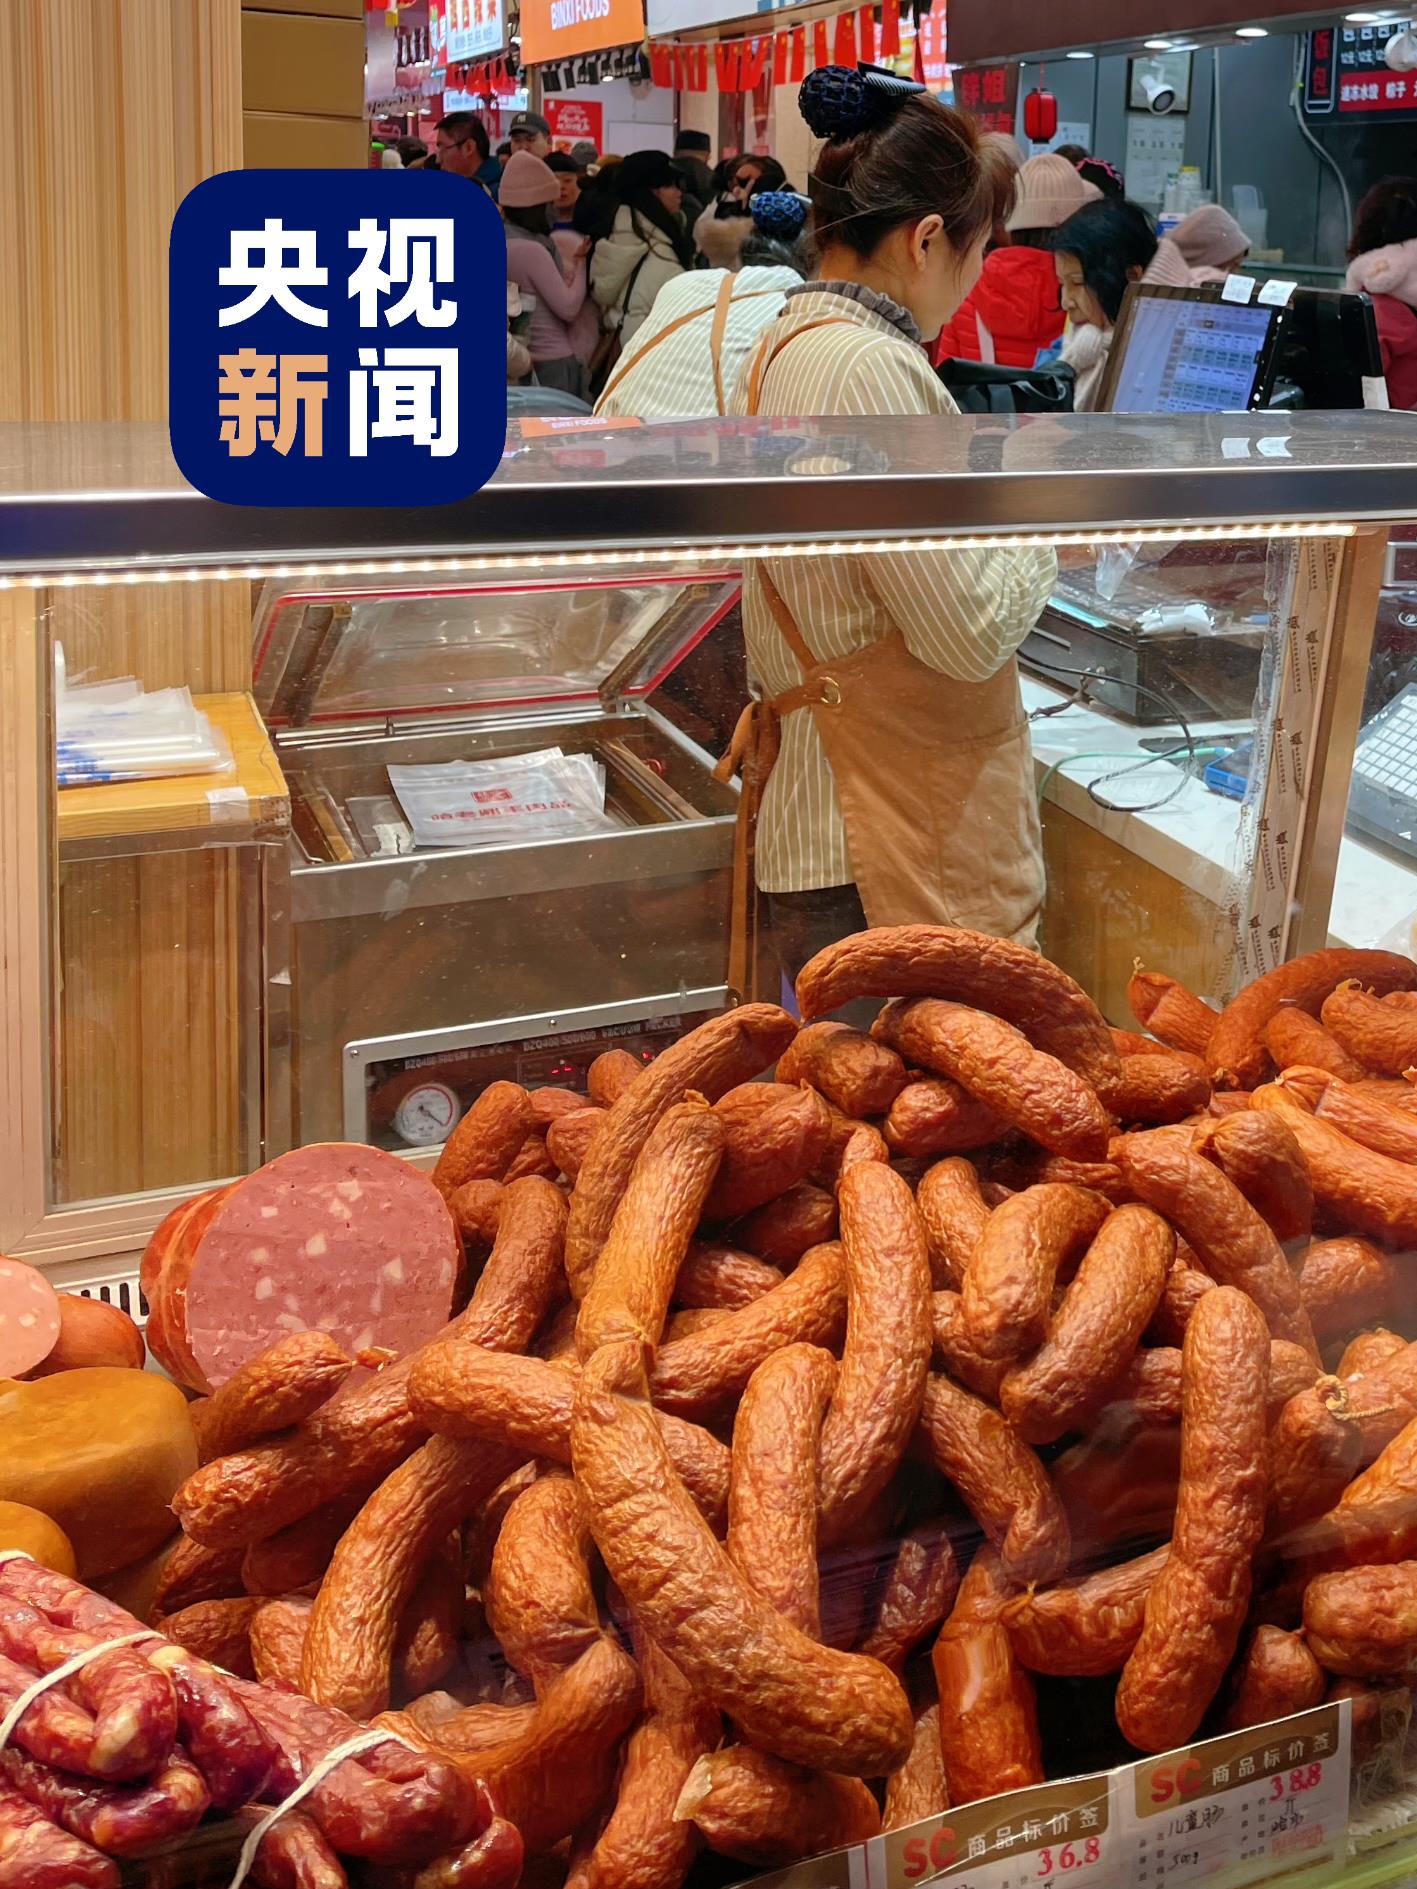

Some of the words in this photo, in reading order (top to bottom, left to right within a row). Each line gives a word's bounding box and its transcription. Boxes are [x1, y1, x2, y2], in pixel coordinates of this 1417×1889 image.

[1150, 1759, 1201, 1802] SC
[1211, 1730, 1332, 1787] 商品标价签
[902, 1827, 957, 1879] SC
[967, 1805, 1100, 1857] 商品标价签
[1037, 1836, 1101, 1877] 36.8
